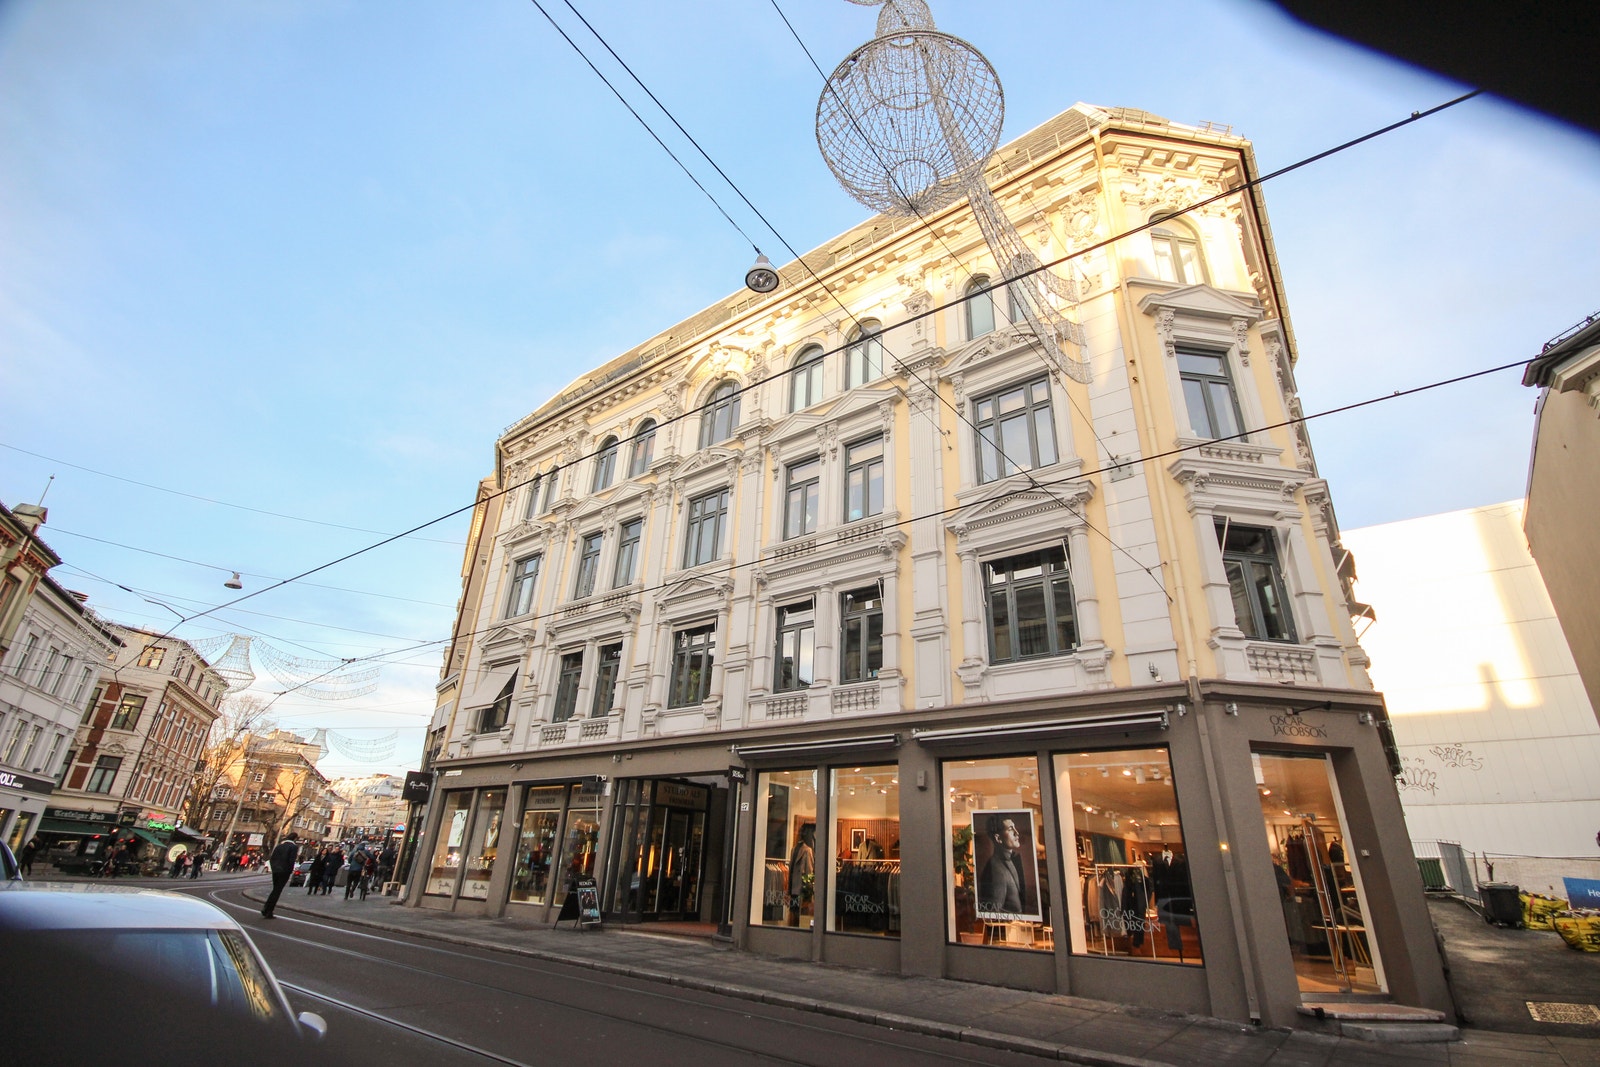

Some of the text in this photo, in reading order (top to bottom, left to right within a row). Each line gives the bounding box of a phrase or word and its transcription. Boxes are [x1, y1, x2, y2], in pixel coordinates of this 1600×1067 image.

[1270, 715, 1313, 727] OSCAR
[1272, 724, 1328, 738] JACOBSON
[844, 894, 872, 904] OSCAR
[845, 902, 885, 914] JACOBSON
[1100, 907, 1138, 920] OSCAR
[1102, 918, 1161, 933] JACOBSON
